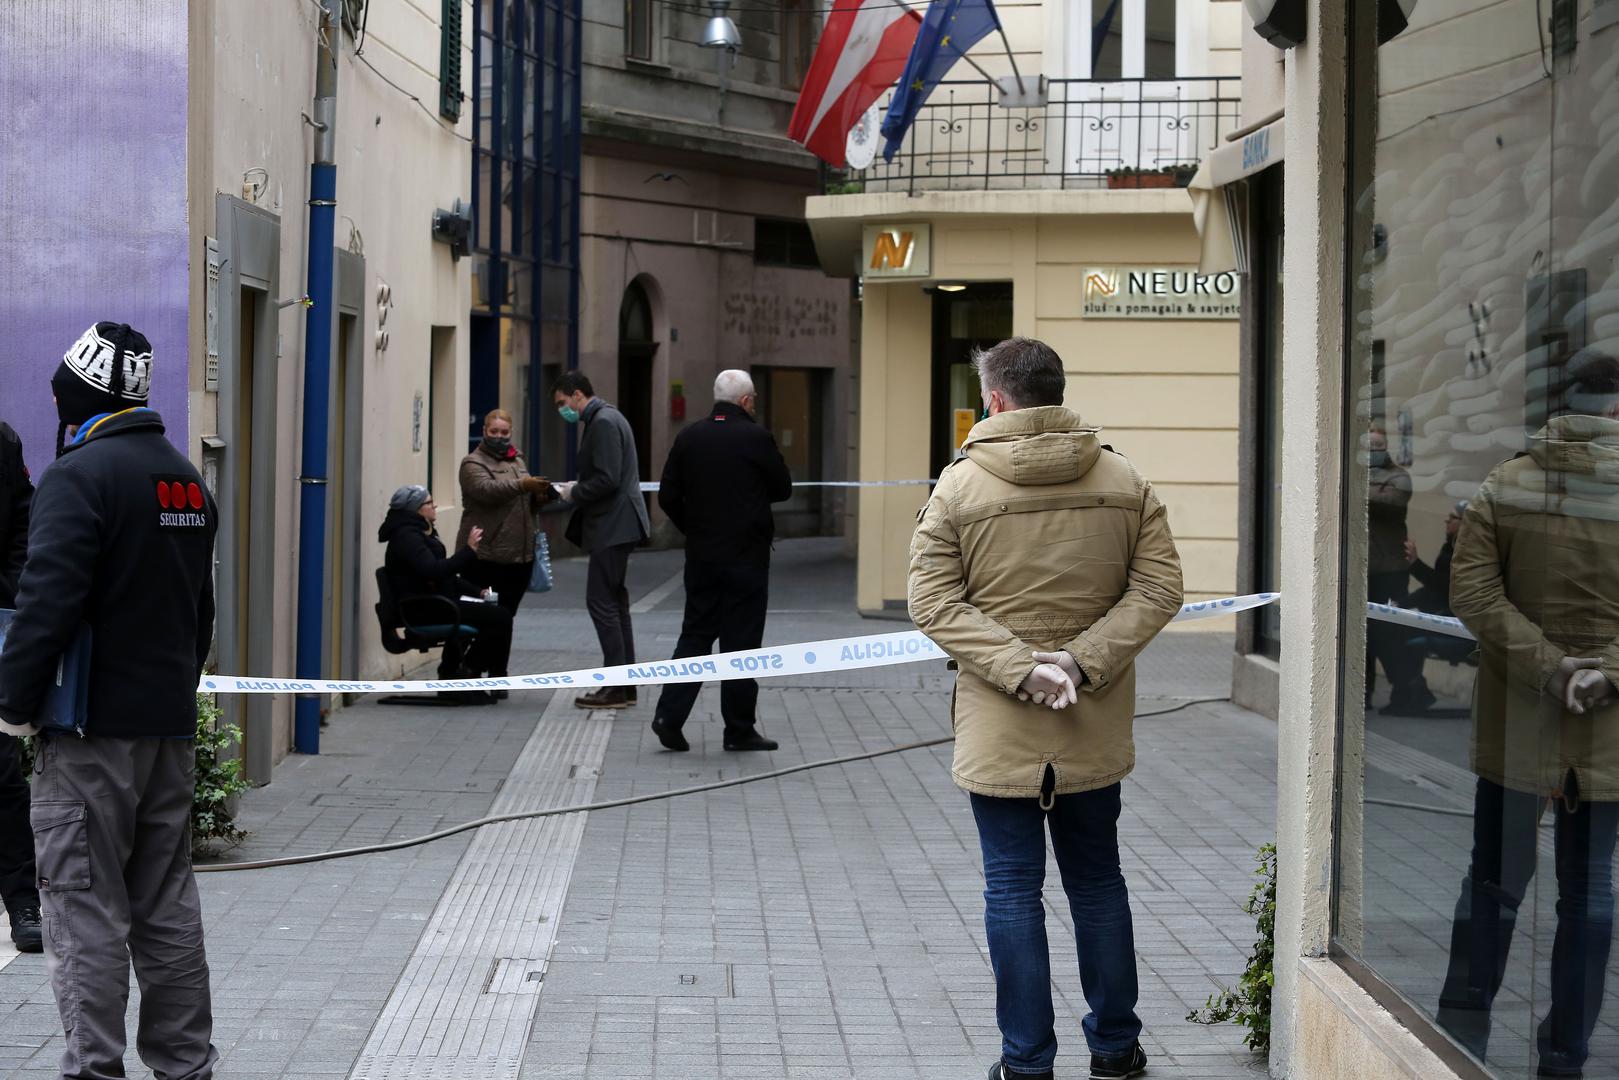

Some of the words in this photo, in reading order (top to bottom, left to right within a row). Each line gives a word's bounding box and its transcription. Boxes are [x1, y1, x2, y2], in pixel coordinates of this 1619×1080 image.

[1242, 127, 1270, 170] BANKA
[1129, 271, 1241, 295] NEURO
[1126, 303, 1183, 315] pomagala
[1187, 303, 1196, 313] &
[160, 512, 206, 527] SECURITAS
